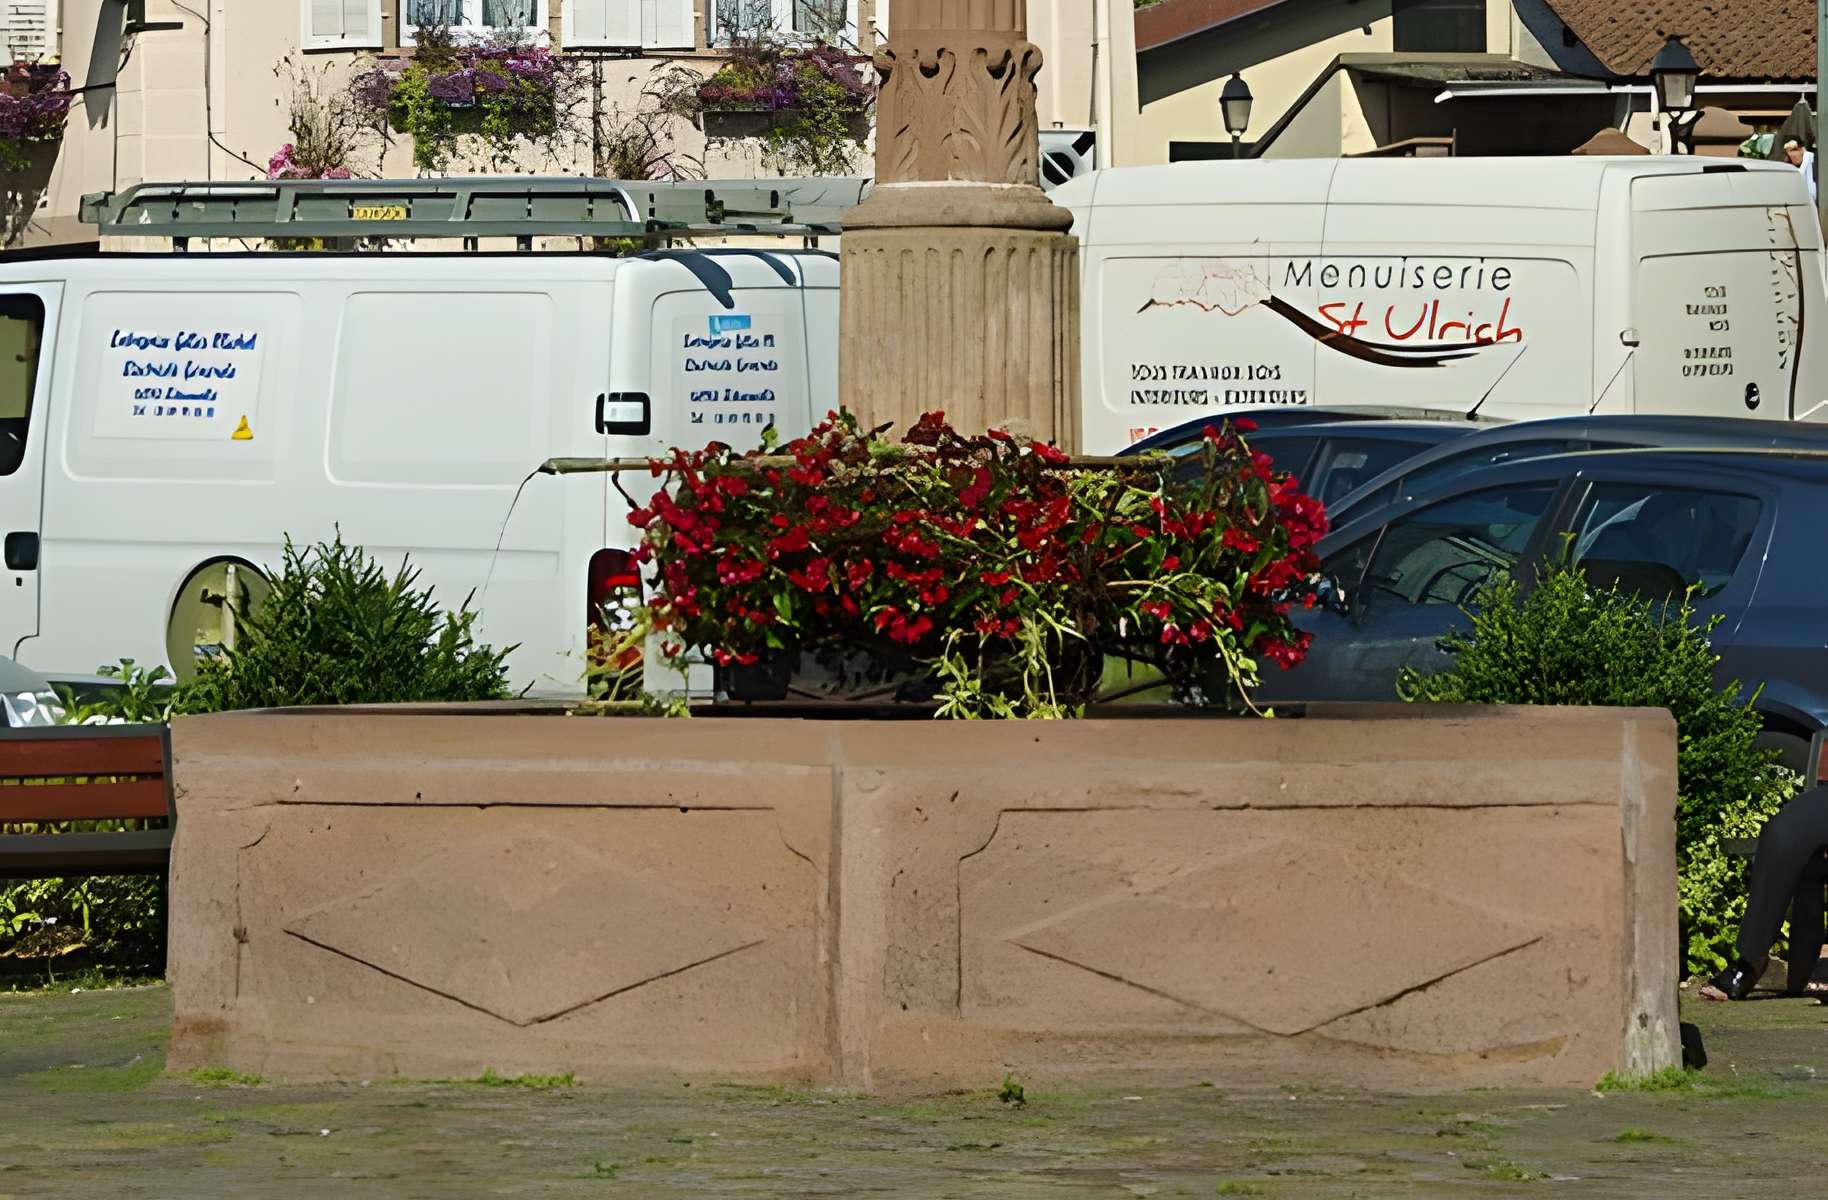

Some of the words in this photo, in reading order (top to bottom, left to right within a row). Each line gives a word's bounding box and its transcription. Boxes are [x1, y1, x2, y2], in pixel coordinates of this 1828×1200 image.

[1283, 257, 1513, 291] Menuiserie
[1318, 301, 1368, 337] St
[1384, 297, 1523, 343] Ulrich
